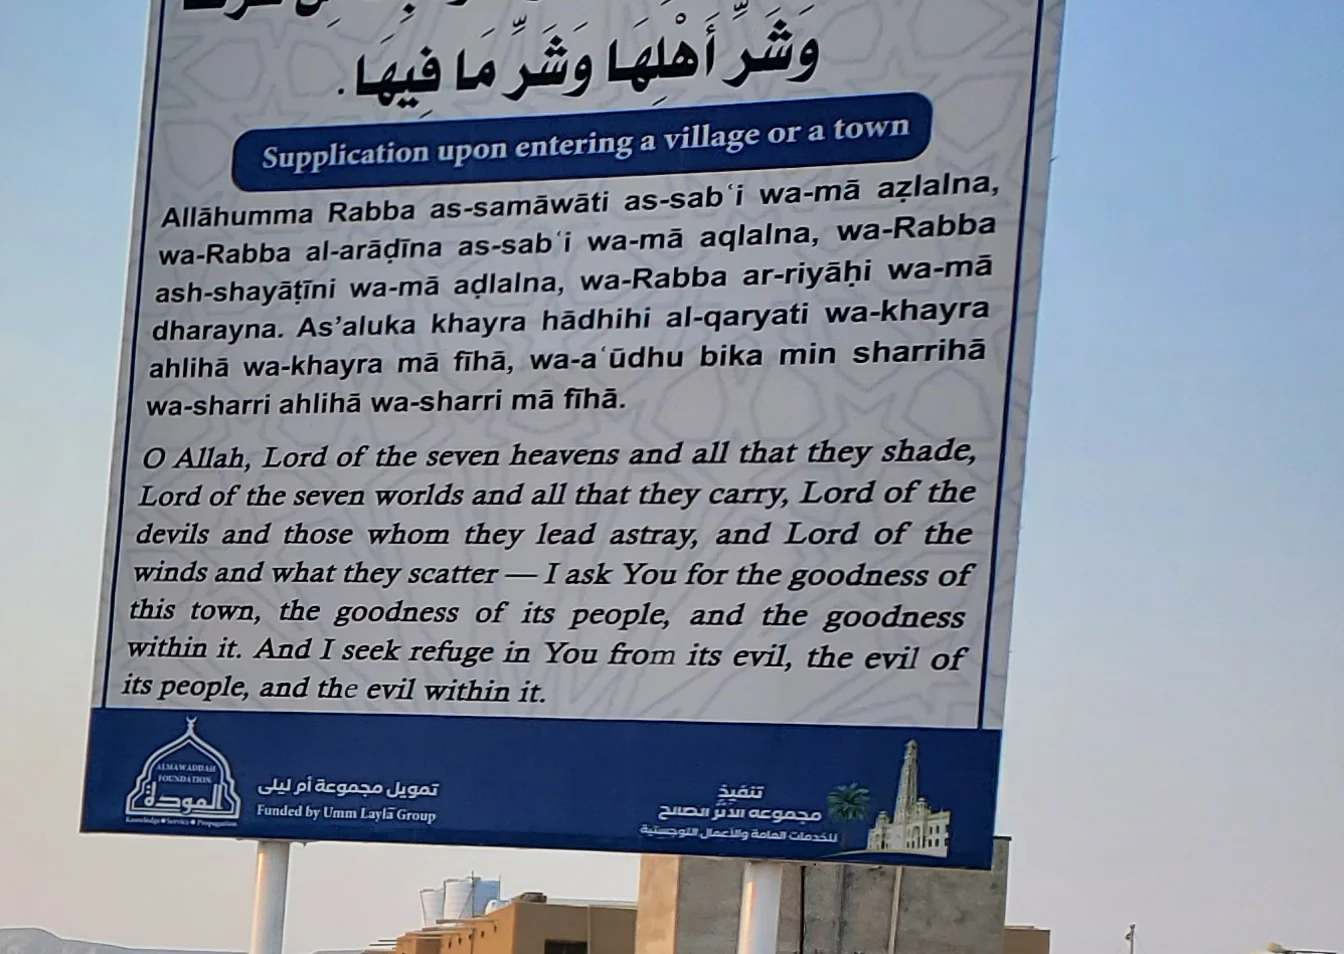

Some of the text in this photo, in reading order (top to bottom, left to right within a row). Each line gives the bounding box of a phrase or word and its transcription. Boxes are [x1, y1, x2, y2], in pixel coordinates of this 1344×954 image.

[263, 119, 908, 174] Supplication upon entering a village or a town
[160, 206, 313, 228] Allāhumma
[328, 199, 415, 223] Rabba
[429, 190, 609, 220] as-samāwāti
[759, 178, 860, 205] wa-mā
[158, 242, 291, 266] wa-Rabba
[587, 227, 683, 252] wa-mā
[699, 222, 819, 253] aqlalna,
[836, 212, 996, 242] wa-Rabba
[349, 275, 440, 298] wa-mā
[580, 265, 727, 291] wa-Rabba
[887, 254, 993, 281] wa-mā
[152, 319, 284, 346] dharayna.
[431, 311, 526, 339] khayra
[542, 306, 651, 331] hādhihi
[665, 301, 809, 333] al-qaryati
[824, 298, 989, 326] wa-khayra
[149, 337, 986, 381] ahlihā wa-khayra mā fīhā, bika min sharrihā
[146, 387, 626, 417] wa-sharri ahlihā wa-sharri mā fīhā.
[143, 437, 976, 474] O Allah, Lord of the seven heavens and all that they shade,
[137, 478, 977, 511] Lord of the seven worlds and all that they carry, Lord of the
[136, 520, 973, 551] devils and those whom they lead astray, and Lord of the
[133, 559, 978, 592] winds and what they scatter I ask You for the goodness of
[129, 597, 966, 634] this town, the goodness of its people, and the goodness
[127, 634, 970, 673] within it. And I seek refuge in You from its evil, the evil of
[120, 672, 546, 704] its people, and the evil within it.
[157, 774, 213, 785] FOUNDATION
[314, 778, 384, 798] مجموعة
[385, 781, 441, 800] تمويل
[256, 803, 303, 818] Funded
[305, 805, 321, 821] by
[323, 806, 358, 819] Umm
[396, 808, 437, 825] Group
